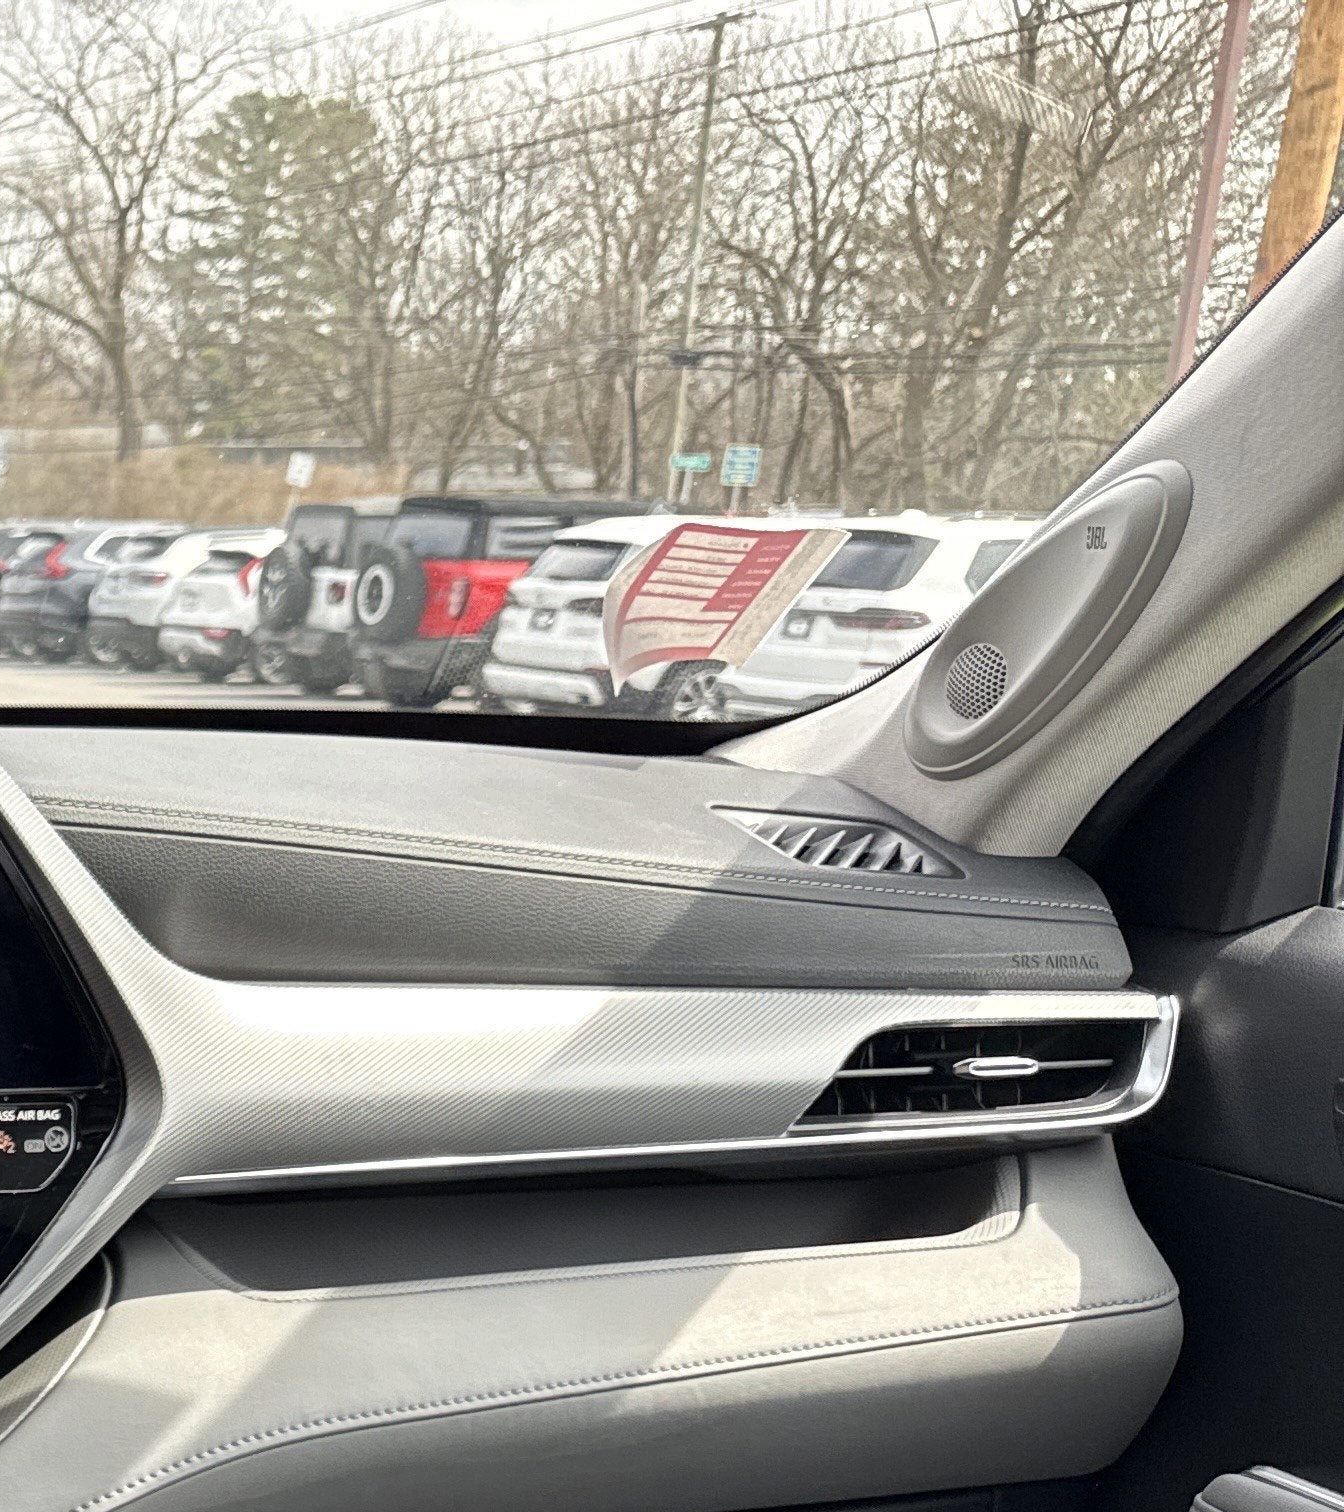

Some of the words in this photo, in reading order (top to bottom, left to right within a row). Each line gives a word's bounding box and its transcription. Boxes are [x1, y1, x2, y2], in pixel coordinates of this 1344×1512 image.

[1086, 526, 1107, 549] JBL
[1011, 954, 1040, 969] SRS
[1045, 955, 1099, 970] AIRBAG
[16, 1109, 36, 1121] AIR
[36, 1109, 62, 1121] BAG
